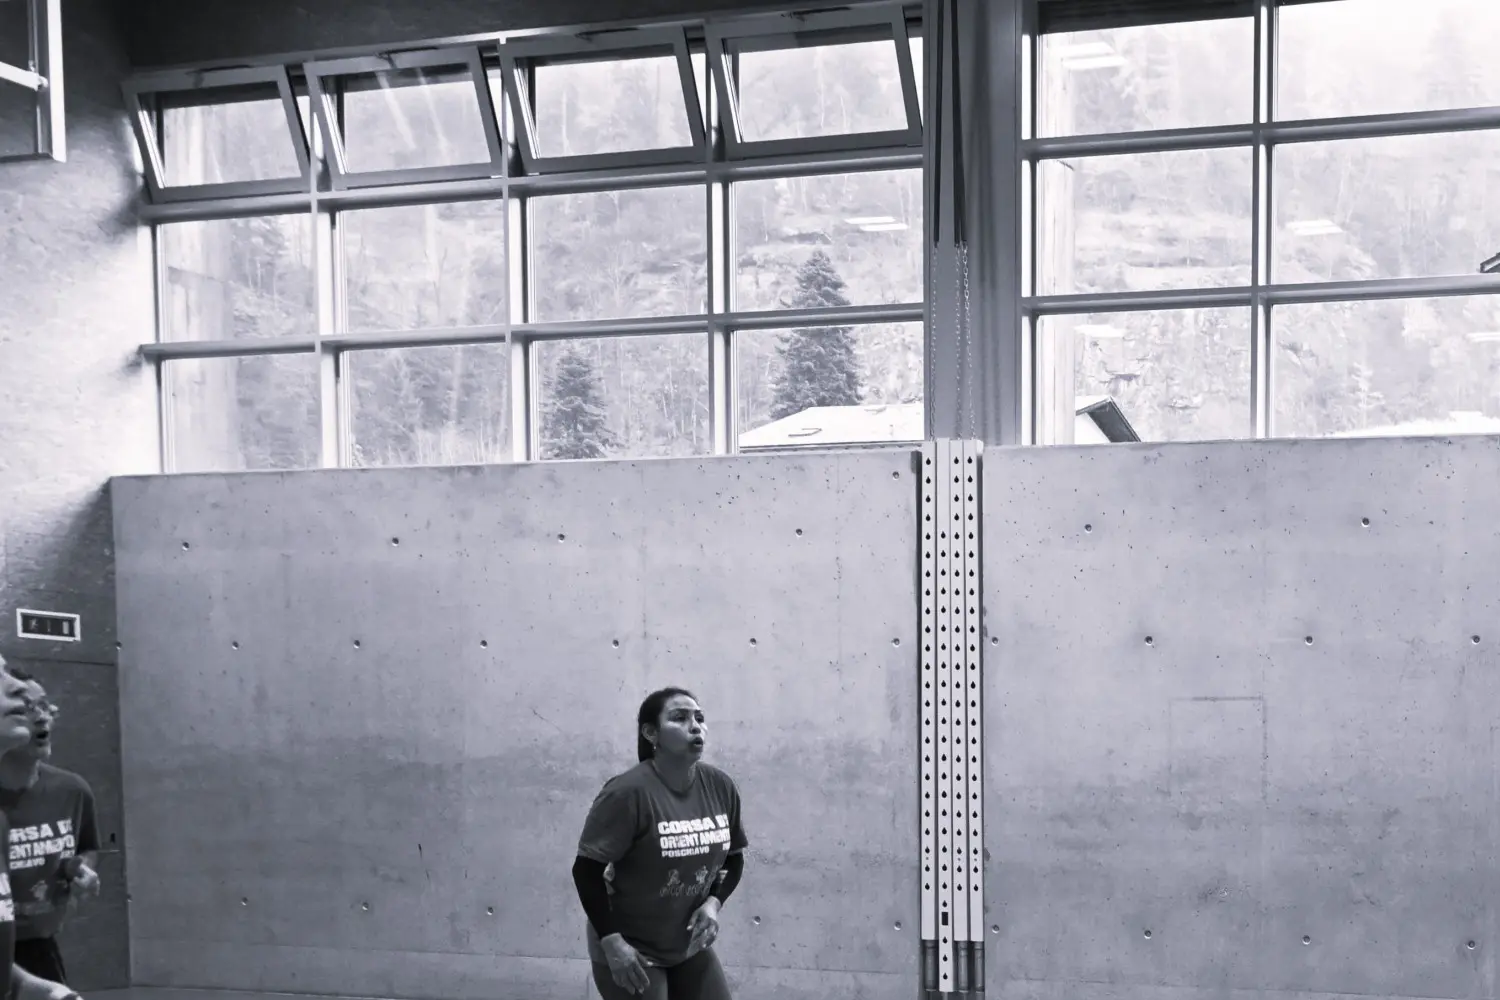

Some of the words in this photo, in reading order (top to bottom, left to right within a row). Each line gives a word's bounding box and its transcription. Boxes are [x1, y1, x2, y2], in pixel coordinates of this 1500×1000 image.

[9, 824, 54, 842] RSA
[657, 817, 716, 834] CORSA
[660, 827, 731, 849] ORIENTAMEN
[661, 845, 710, 857] POSCHIAVO
